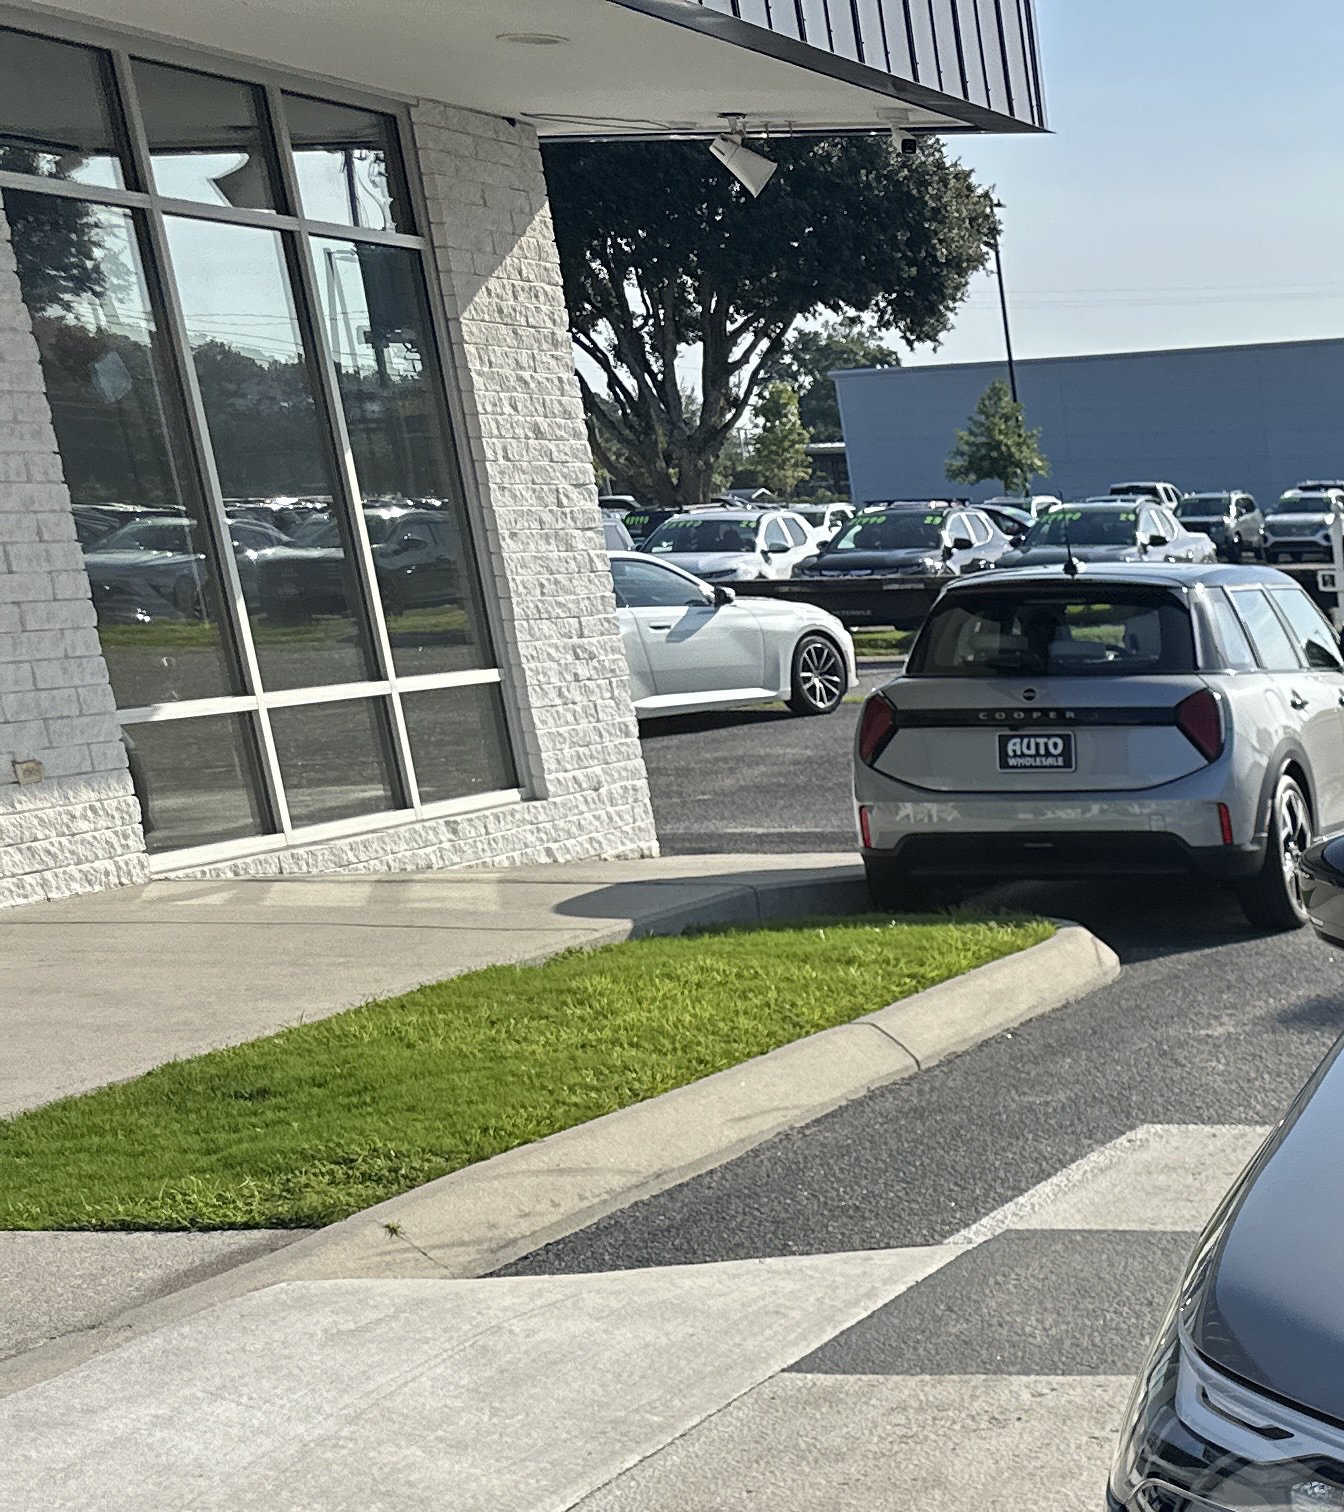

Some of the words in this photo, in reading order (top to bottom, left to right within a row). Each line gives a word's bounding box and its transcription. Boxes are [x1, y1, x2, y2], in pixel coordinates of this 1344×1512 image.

[978, 711, 1075, 720] COOPER
[1007, 737, 1064, 757] AUTO
[1007, 756, 1064, 767] WHOLESALE
